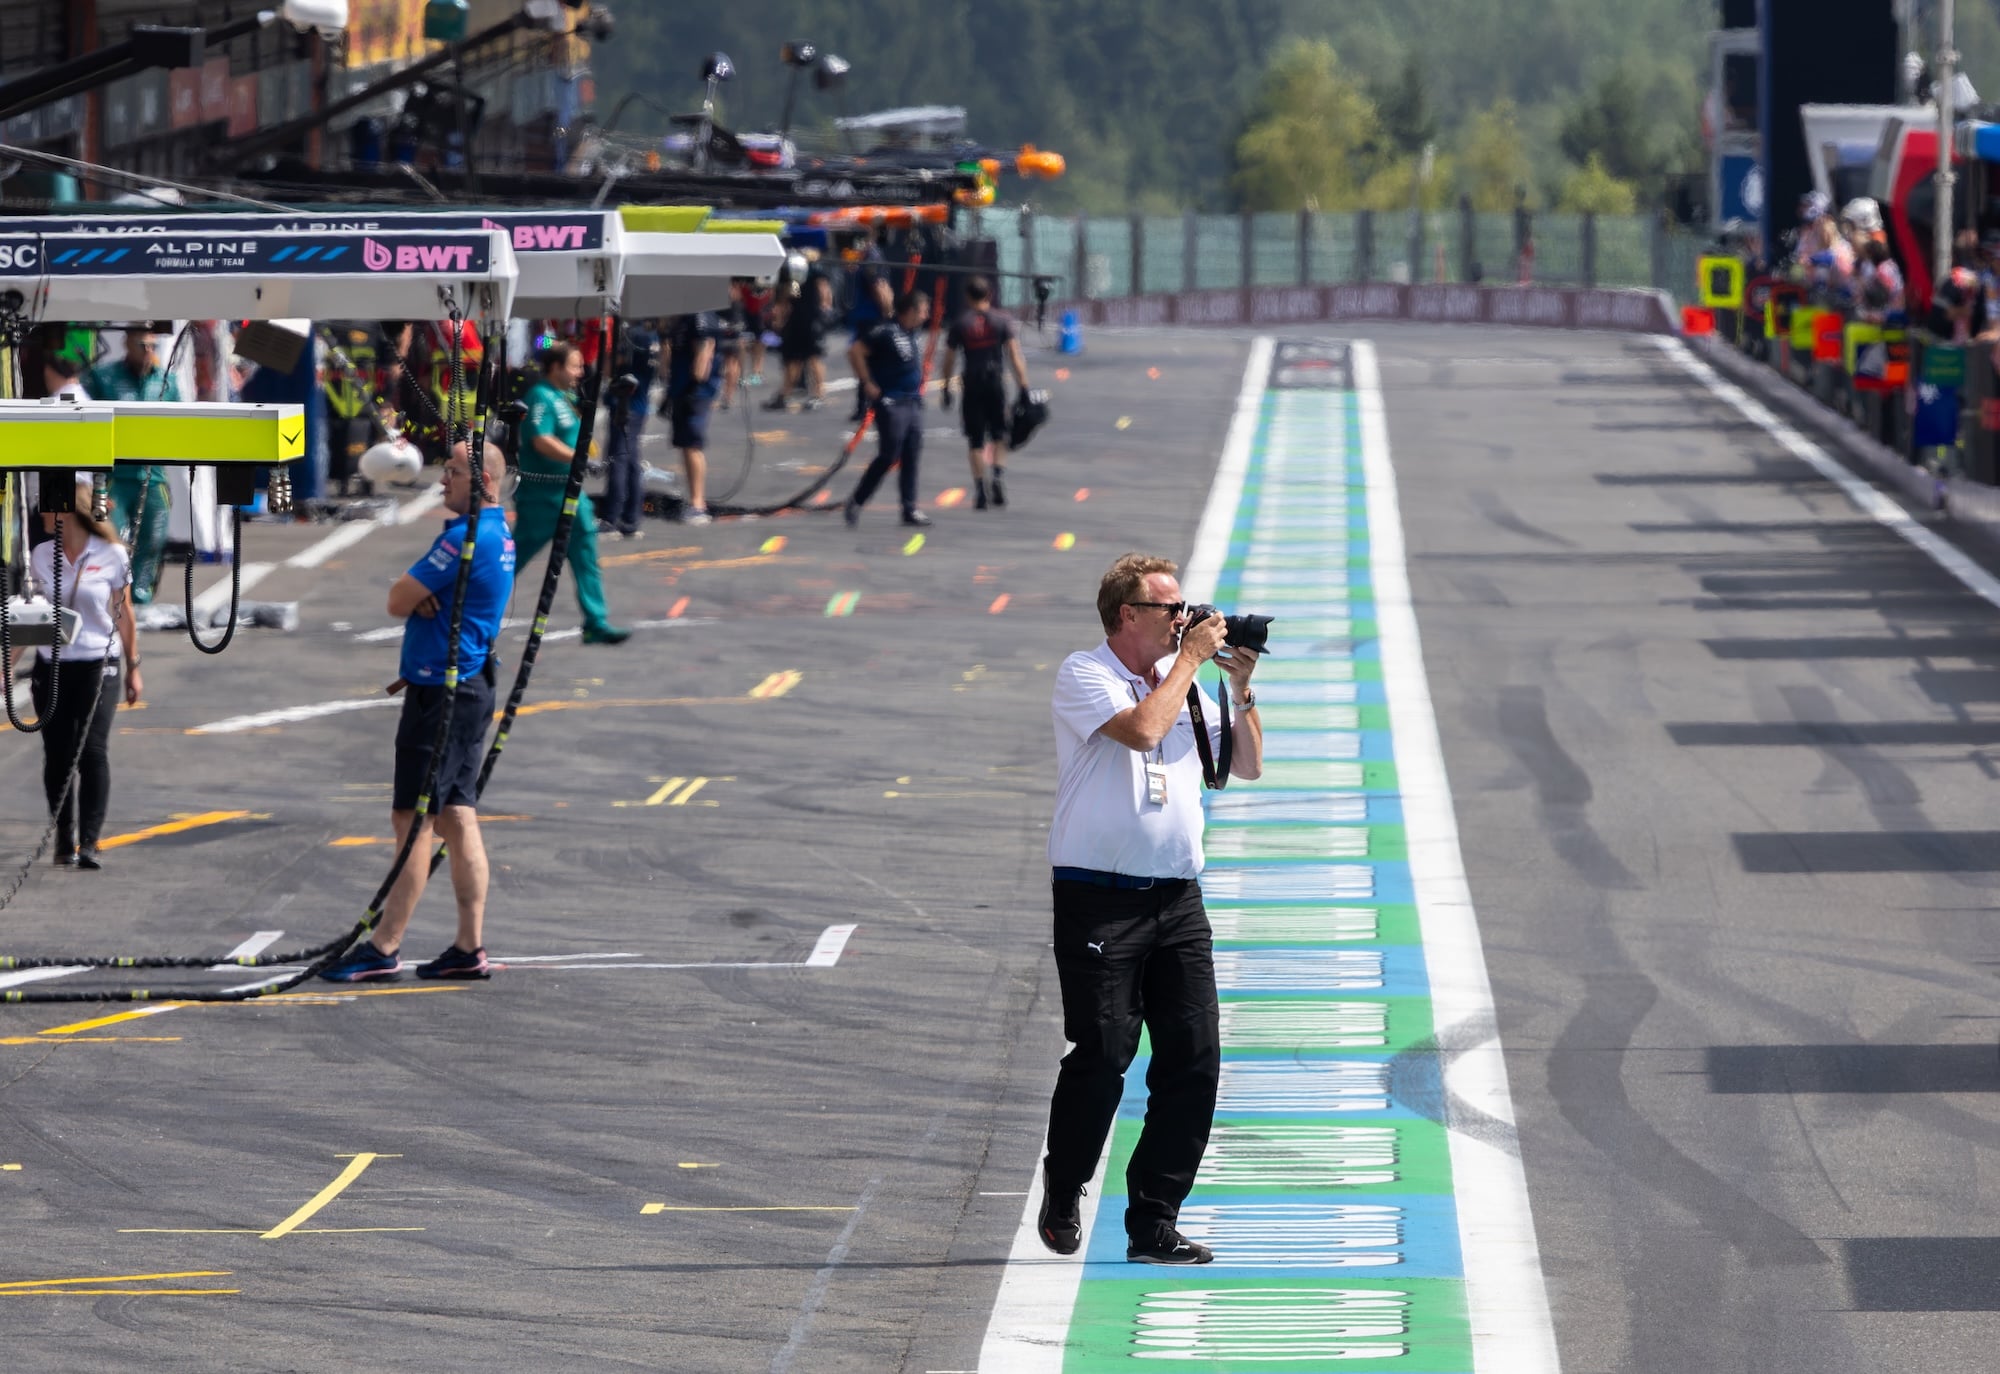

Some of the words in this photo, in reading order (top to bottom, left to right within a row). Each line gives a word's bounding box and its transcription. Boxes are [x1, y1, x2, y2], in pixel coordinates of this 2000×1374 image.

[513, 225, 588, 249] BWT
[145, 242, 258, 254] ALPINE
[395, 246, 473, 270] BWT
[155, 257, 196, 268] FORMULA
[222, 257, 245, 266] TEAM
[1191, 705, 1201, 723] EOS
[1127, 1288, 1410, 1360] aramco
